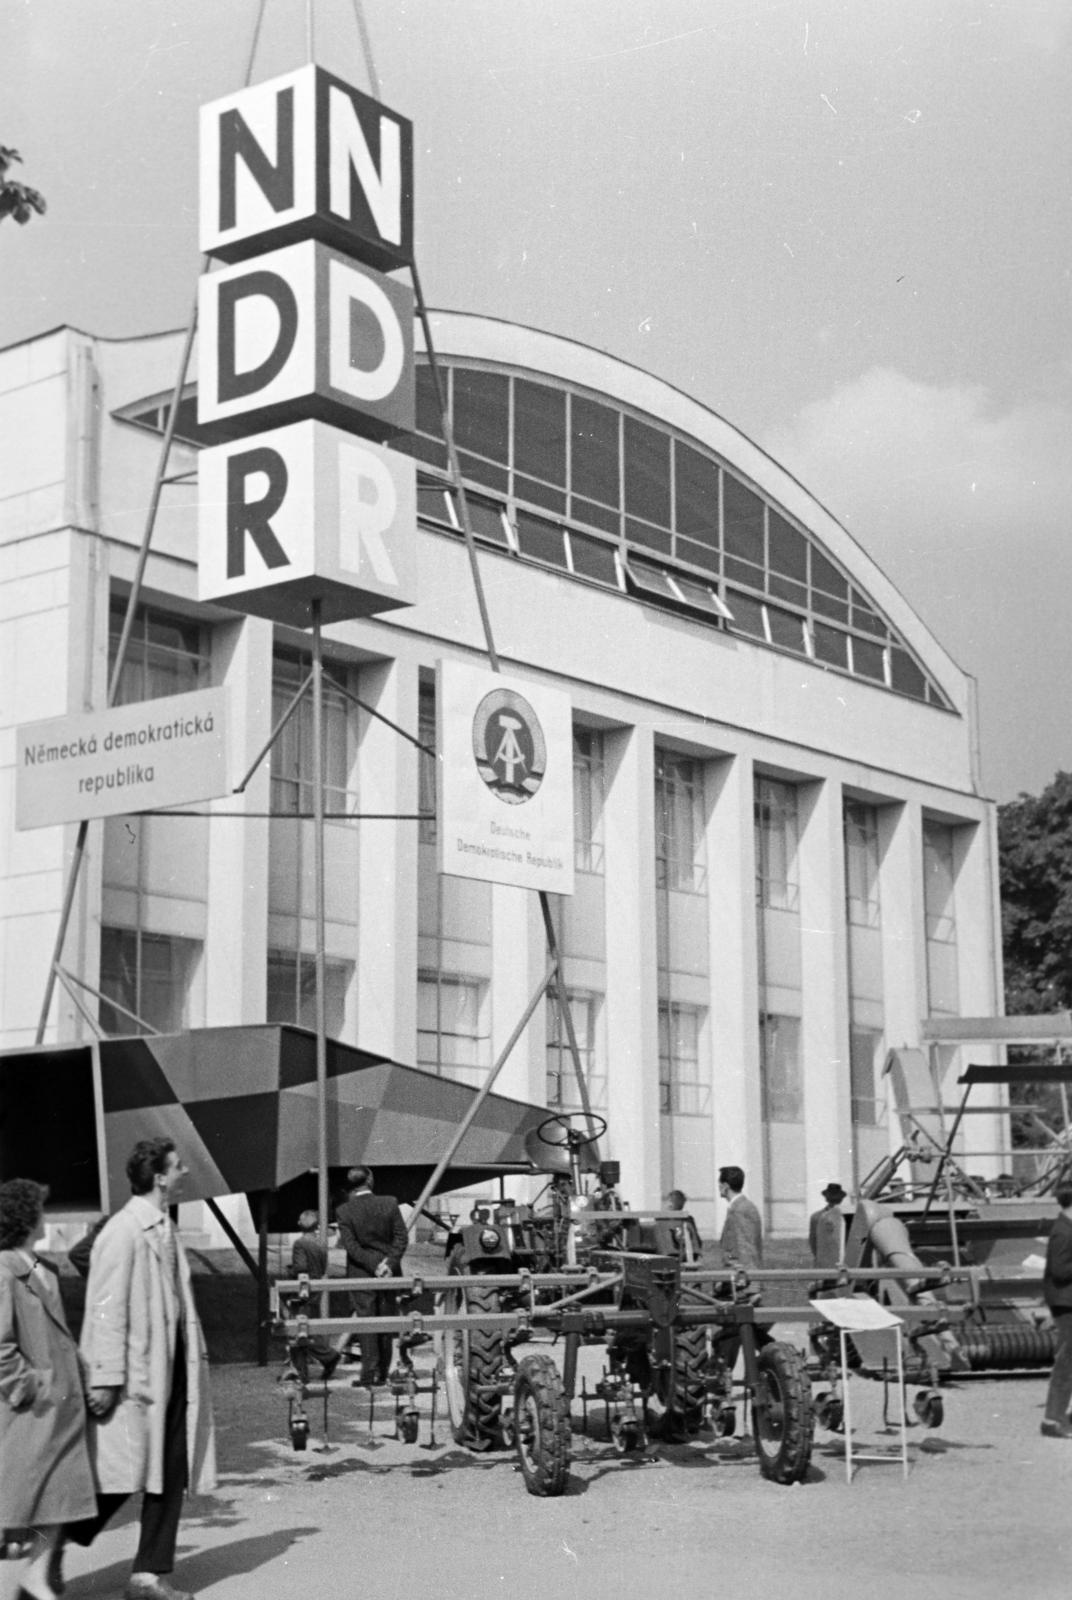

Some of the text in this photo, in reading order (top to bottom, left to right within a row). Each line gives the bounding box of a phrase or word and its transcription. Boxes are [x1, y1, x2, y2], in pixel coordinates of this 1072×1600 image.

[25, 712, 214, 766] Německá demokratická
[78, 766, 154, 794] republika
[490, 821, 531, 840] Deutsche
[457, 839, 563, 869] Demokratische Republik
